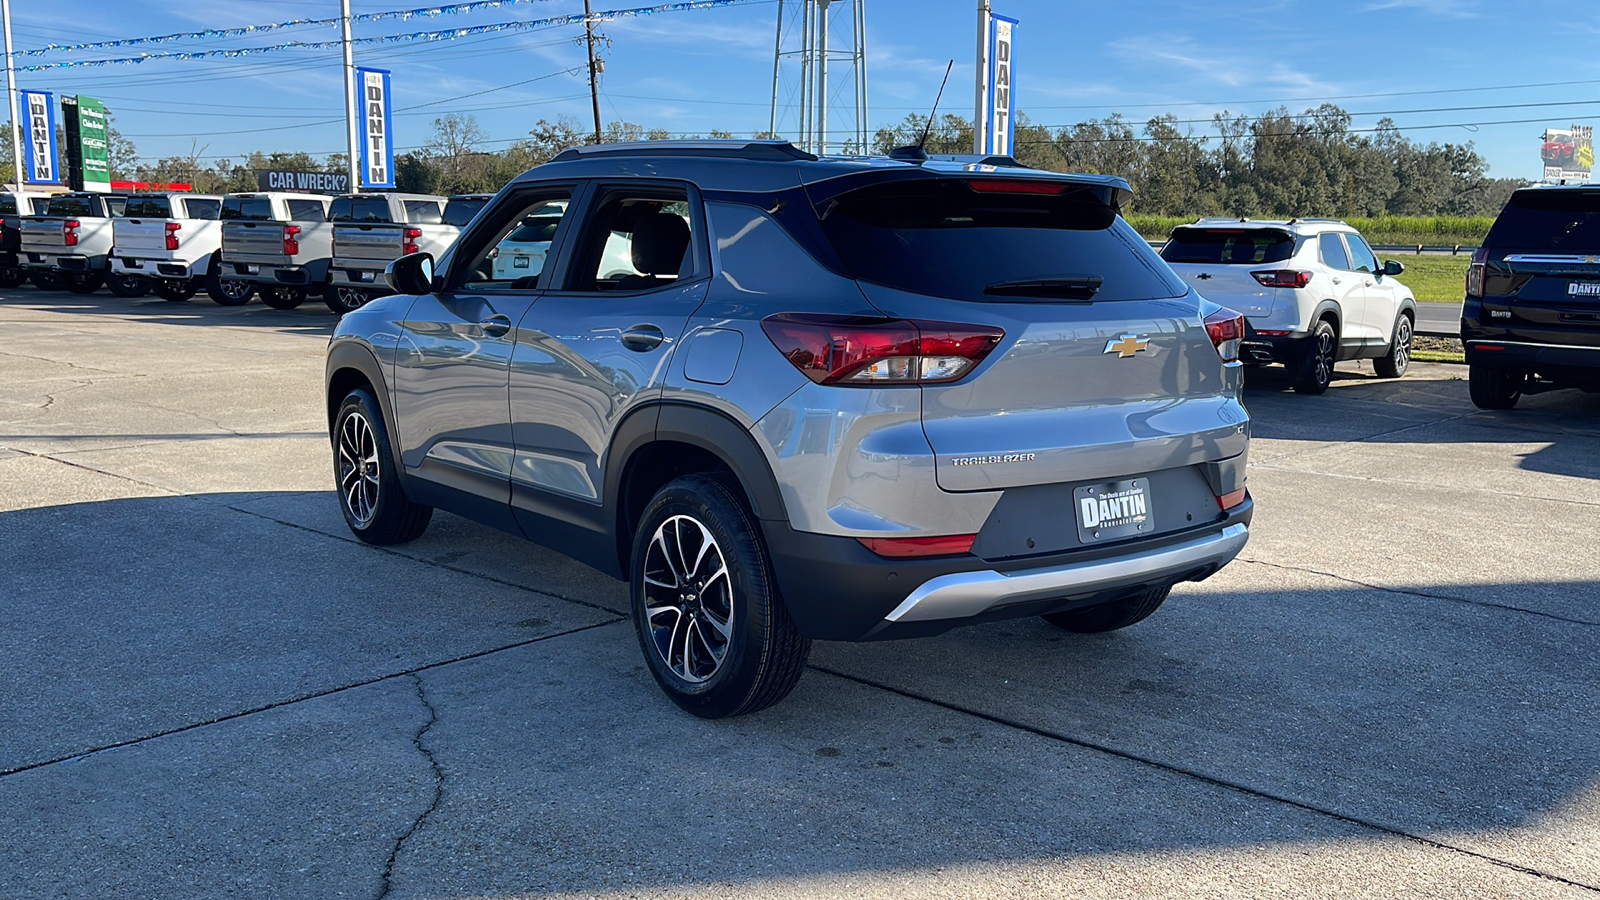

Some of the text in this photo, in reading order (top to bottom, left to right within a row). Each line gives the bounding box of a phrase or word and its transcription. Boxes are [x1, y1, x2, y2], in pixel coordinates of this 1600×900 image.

[996, 40, 1009, 155] DANTI
[32, 104, 49, 178] DANTIN
[368, 86, 384, 182] DANTIN
[269, 171, 347, 190] CAR WRECK?
[1568, 283, 1600, 294] DANTI
[951, 453, 1035, 466] TRAILBLAZER
[1080, 494, 1146, 528] DANTIN
[1099, 518, 1132, 528] Chevrolet
